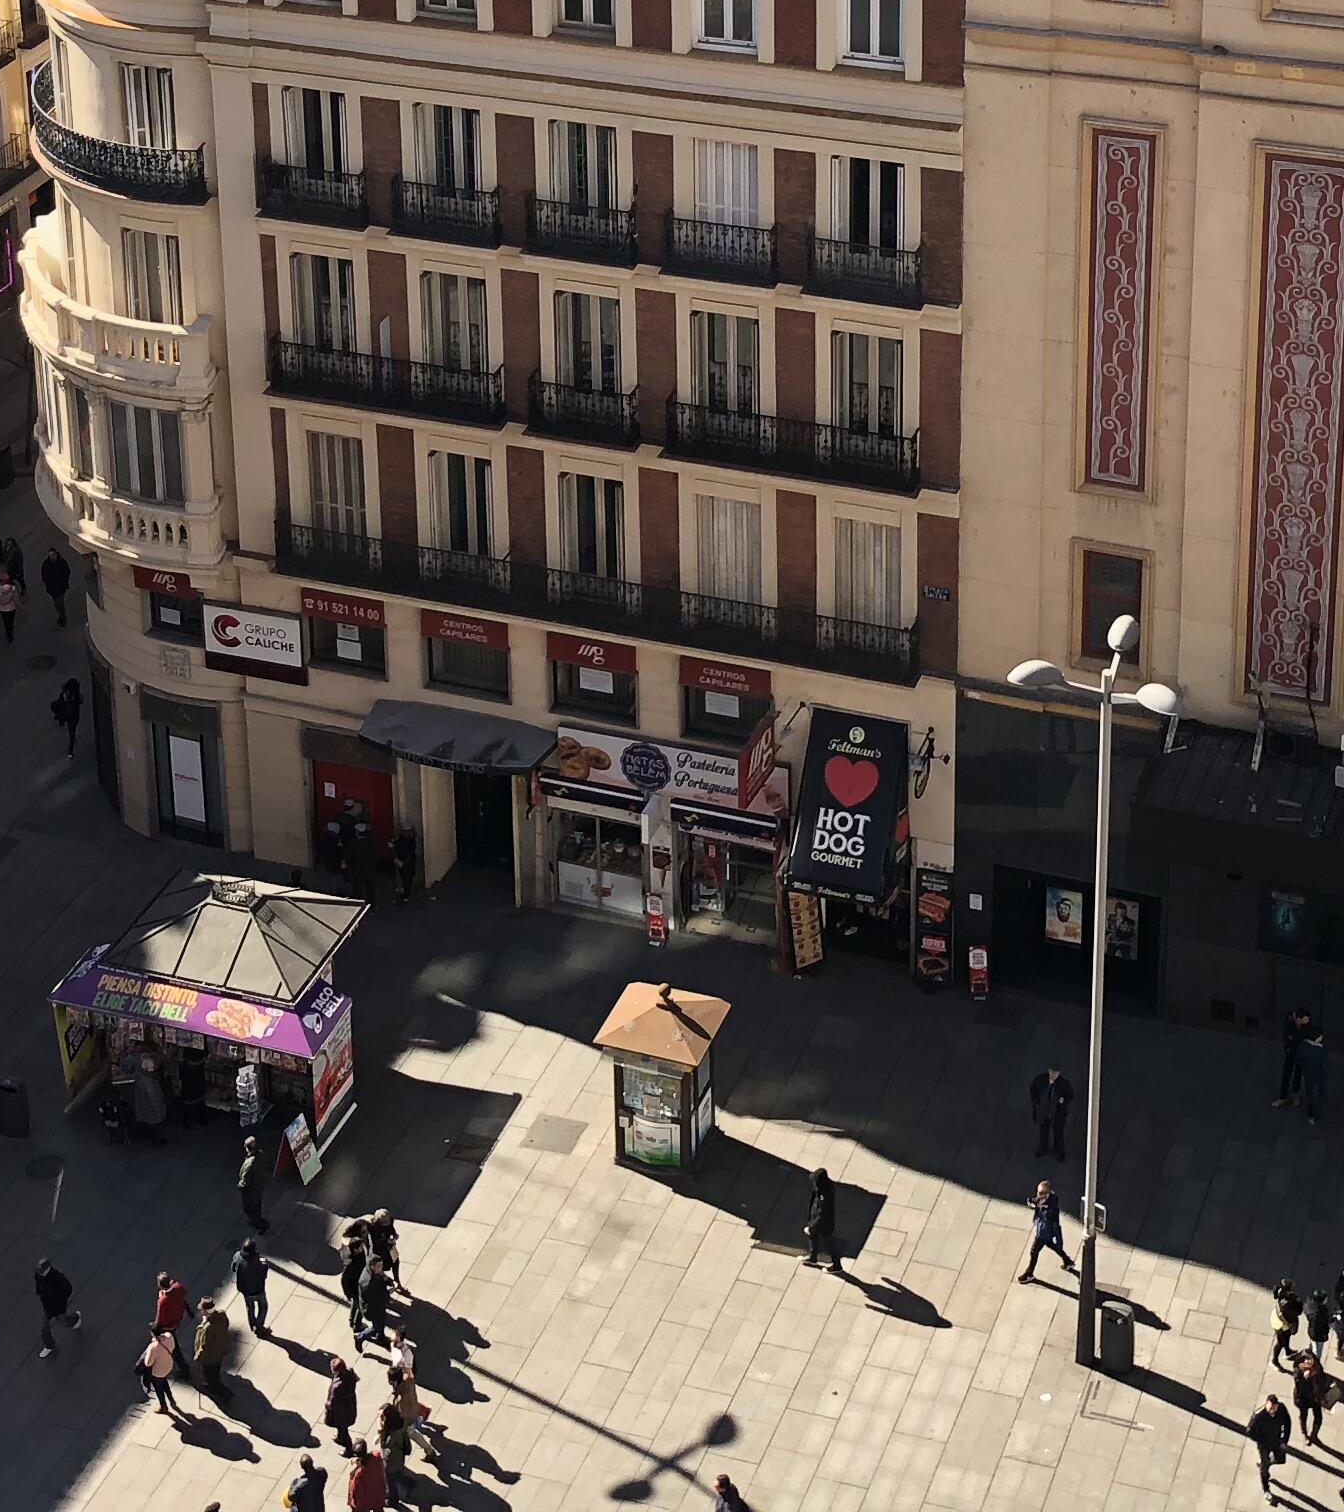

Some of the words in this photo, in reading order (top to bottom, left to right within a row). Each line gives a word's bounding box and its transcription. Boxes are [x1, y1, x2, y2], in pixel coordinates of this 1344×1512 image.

[316, 599, 329, 611] 91
[332, 602, 349, 616] 521
[353, 606, 365, 618] 14
[367, 609, 380, 621] 00
[244, 623, 287, 639] GRUPO
[439, 627, 488, 643] CAPILARES
[443, 619, 485, 634] CENTROS
[245, 637, 295, 653] CALICHE
[699, 675, 750, 693] CAPILARES
[702, 666, 747, 683] CENTROS
[827, 738, 882, 759] Feltman's
[625, 753, 666, 770] NATAS
[816, 806, 872, 837] HOT
[812, 829, 866, 856] DOG
[810, 850, 864, 870] GOURMET
[97, 973, 143, 995] PIENSA
[142, 982, 199, 1006] DISTINTO,
[310, 986, 334, 1013] TACO
[92, 990, 128, 1011] ELIGE
[127, 996, 159, 1017] TACO
[158, 1003, 192, 1023] BELL
[323, 993, 346, 1019] BELL
